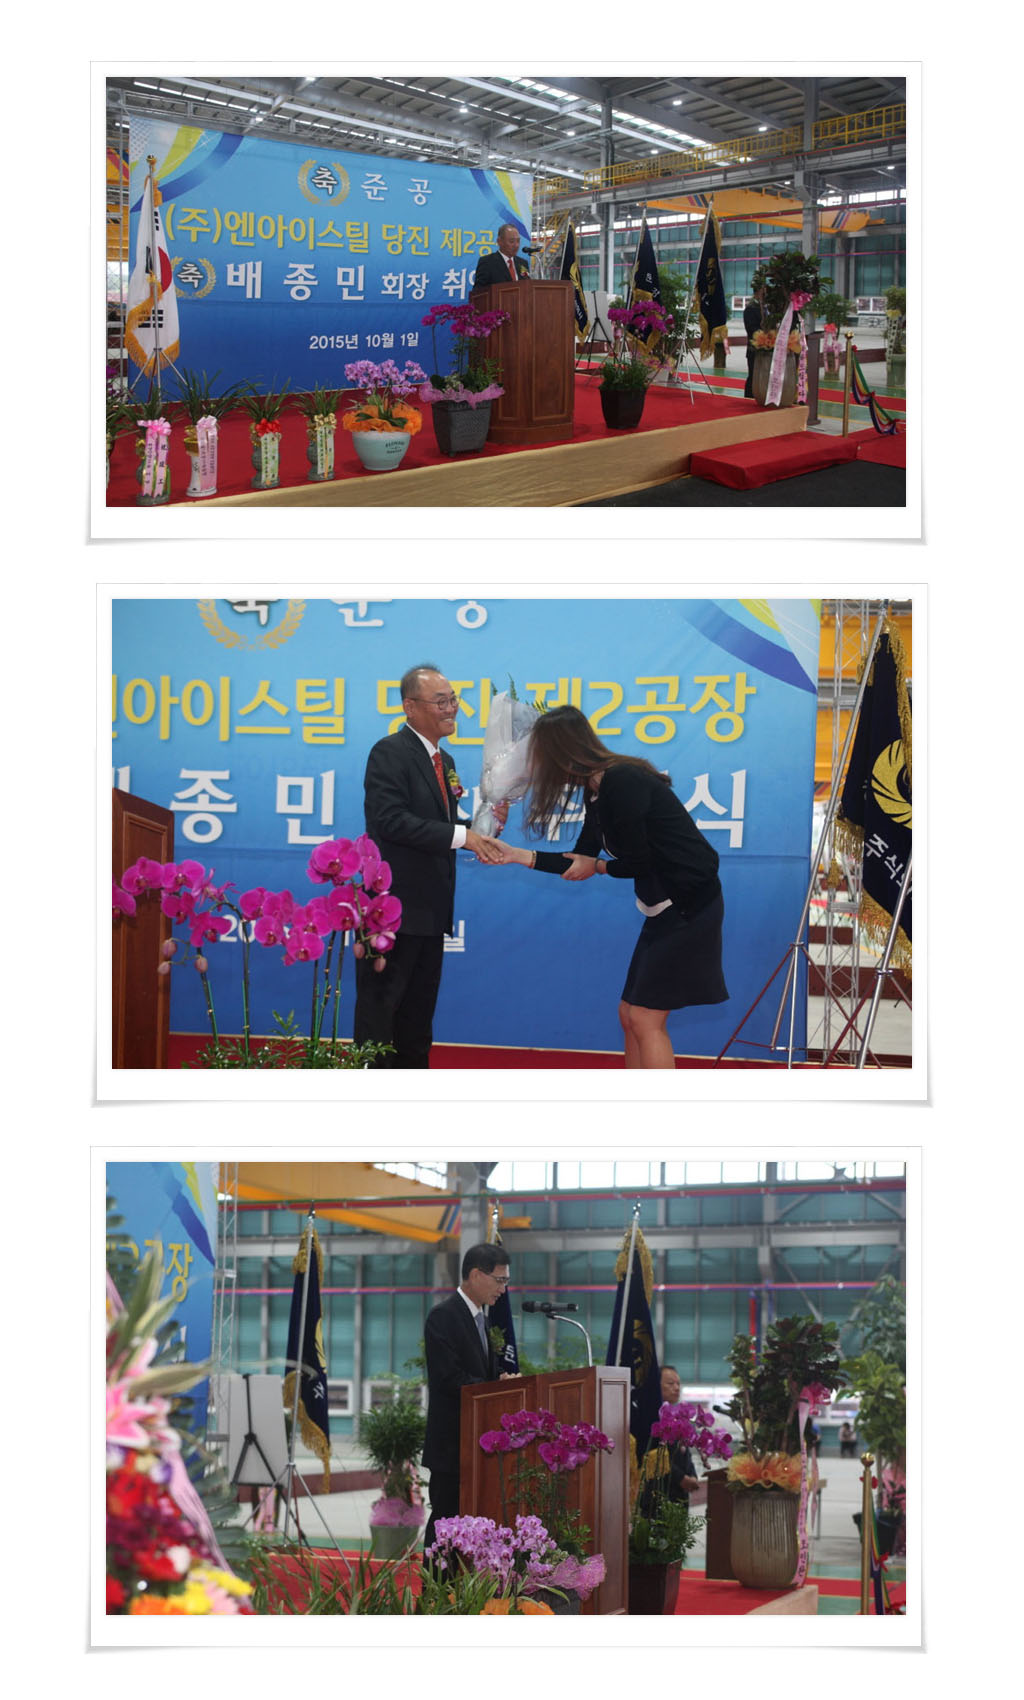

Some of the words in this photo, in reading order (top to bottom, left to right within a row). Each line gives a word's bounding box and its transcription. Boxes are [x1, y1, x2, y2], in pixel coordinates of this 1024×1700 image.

[311, 166, 338, 196] 축
[165, 203, 369, 255] (주)엔아이스틸
[381, 223, 430, 256] 당진
[440, 227, 499, 257] 제2공
[176, 263, 204, 290] 축
[381, 272, 430, 300] 회장
[309, 333, 359, 350] 2015년
[365, 332, 395, 349] 10월
[400, 331, 419, 348] 1일
[112, 674, 345, 745] 아이스틸
